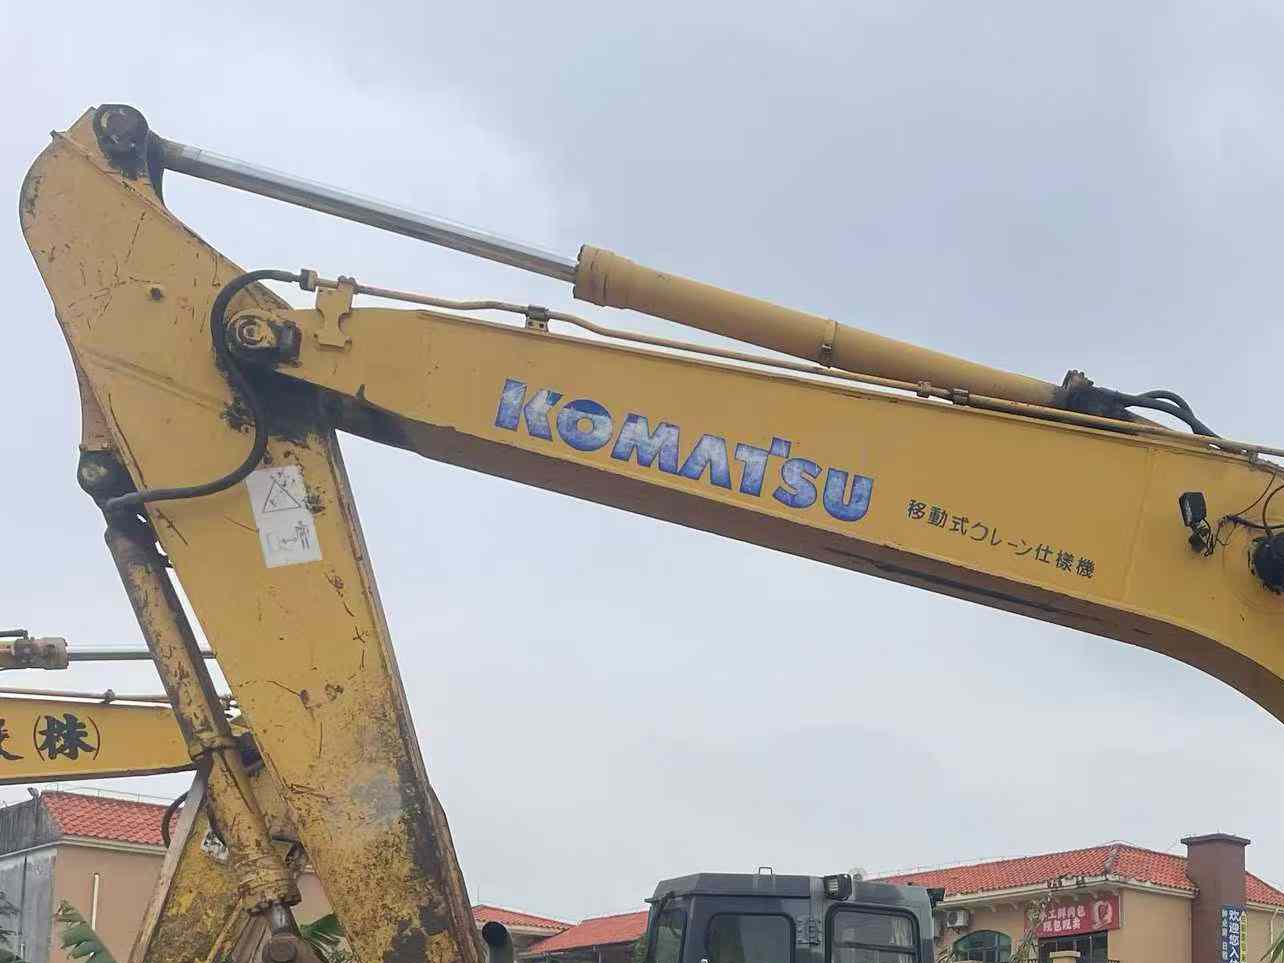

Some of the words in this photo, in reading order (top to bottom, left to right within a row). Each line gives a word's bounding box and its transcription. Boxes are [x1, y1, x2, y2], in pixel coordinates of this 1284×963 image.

[495, 378, 874, 523] KOMATSU
[906, 499, 1095, 579] 移動式クレーン仕様機
